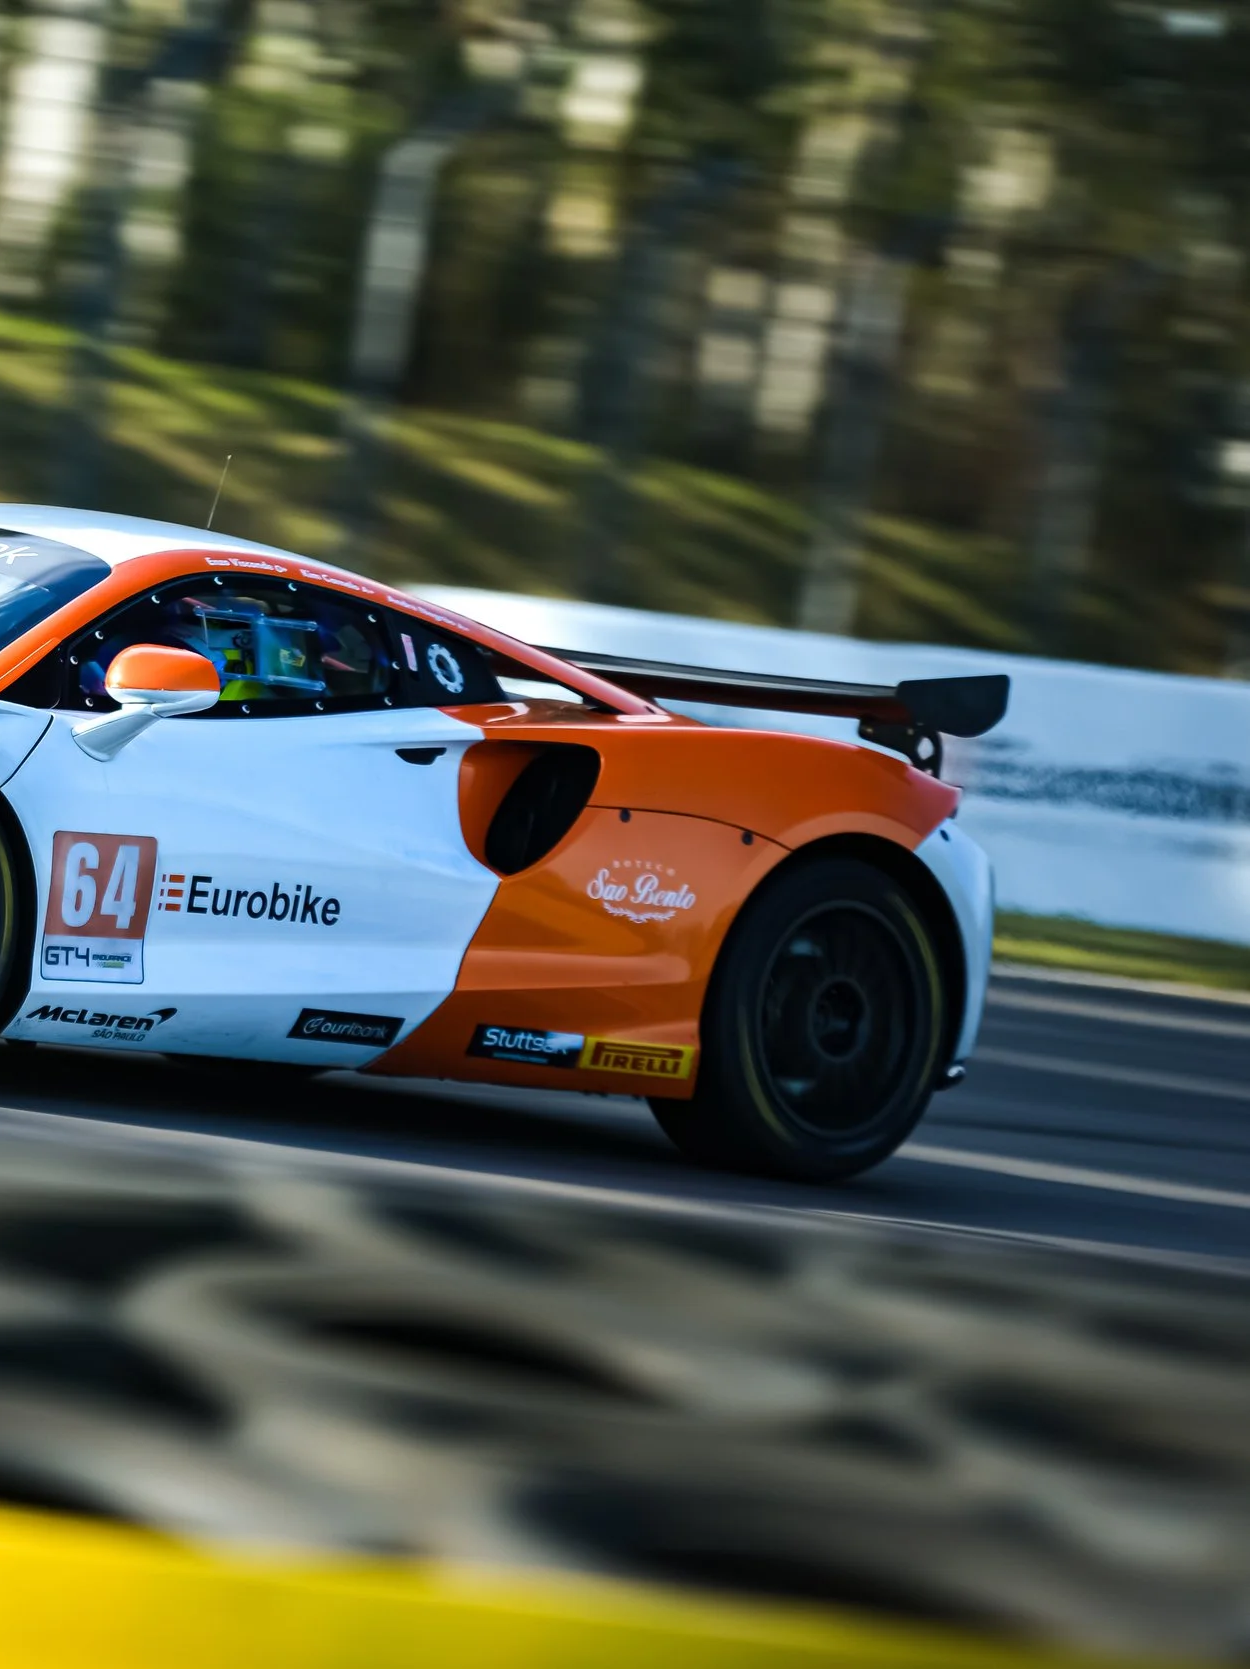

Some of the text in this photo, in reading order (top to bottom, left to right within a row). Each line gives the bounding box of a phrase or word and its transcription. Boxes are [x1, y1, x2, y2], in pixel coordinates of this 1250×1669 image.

[61, 841, 140, 929] 64
[186, 875, 341, 926] Eurobike
[630, 874, 696, 910] Bento
[44, 945, 90, 968] GT4
[114, 1030, 146, 1042] PAULO
[590, 1041, 684, 1075] PIRELLI
